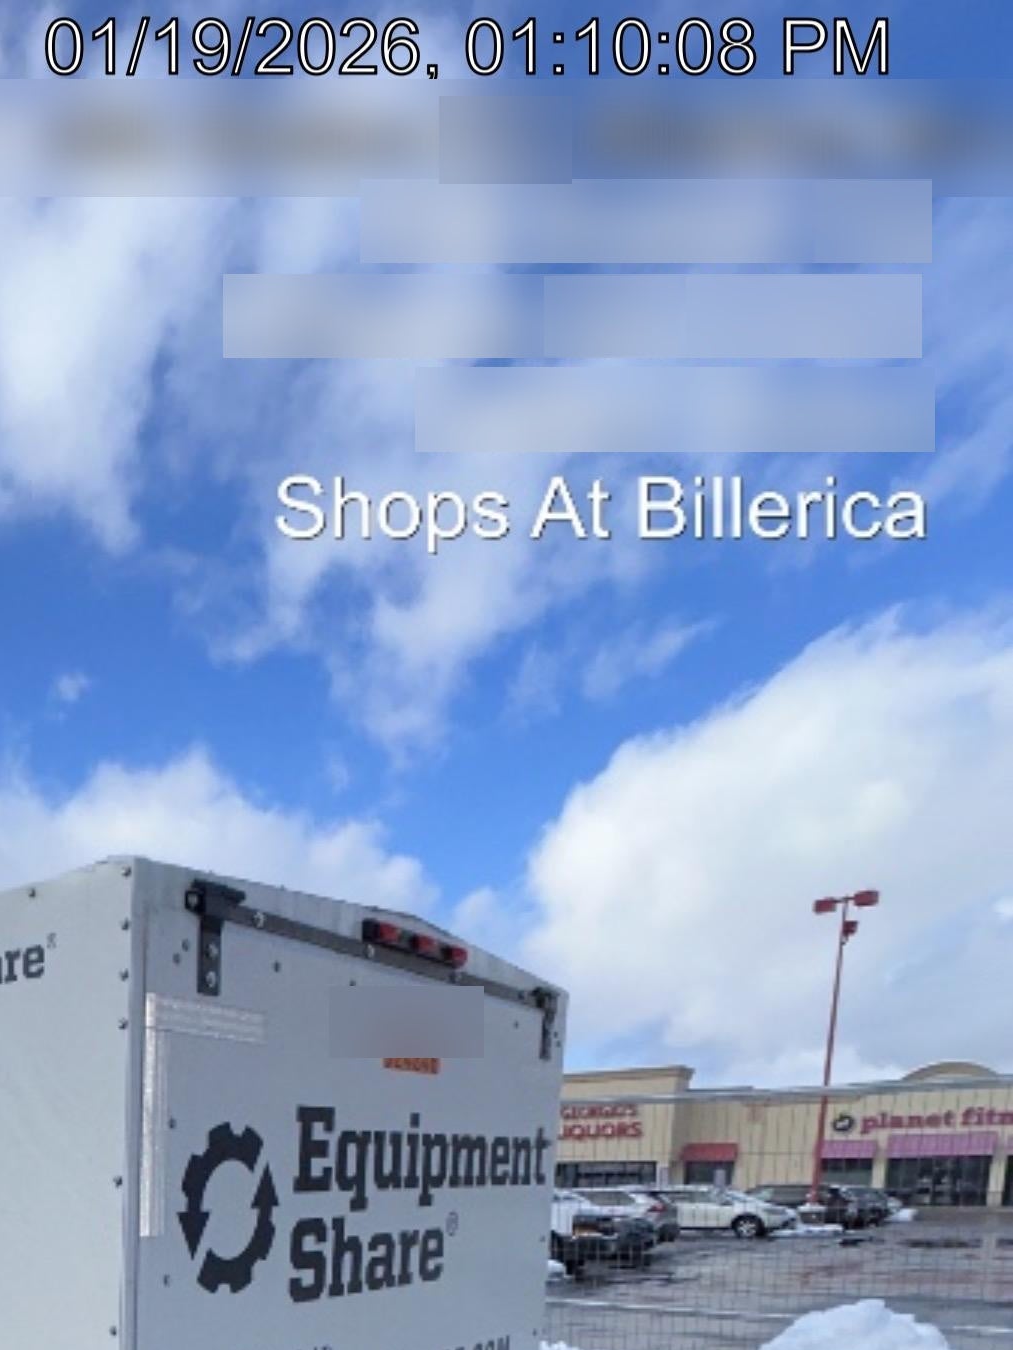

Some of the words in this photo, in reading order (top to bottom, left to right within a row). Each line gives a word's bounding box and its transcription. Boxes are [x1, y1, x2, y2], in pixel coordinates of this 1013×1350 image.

[558, 1120, 643, 1140] IQUORS
[860, 1110, 955, 1134] planet
[293, 1105, 551, 1211] Equipment
[289, 1215, 445, 1303] Share
